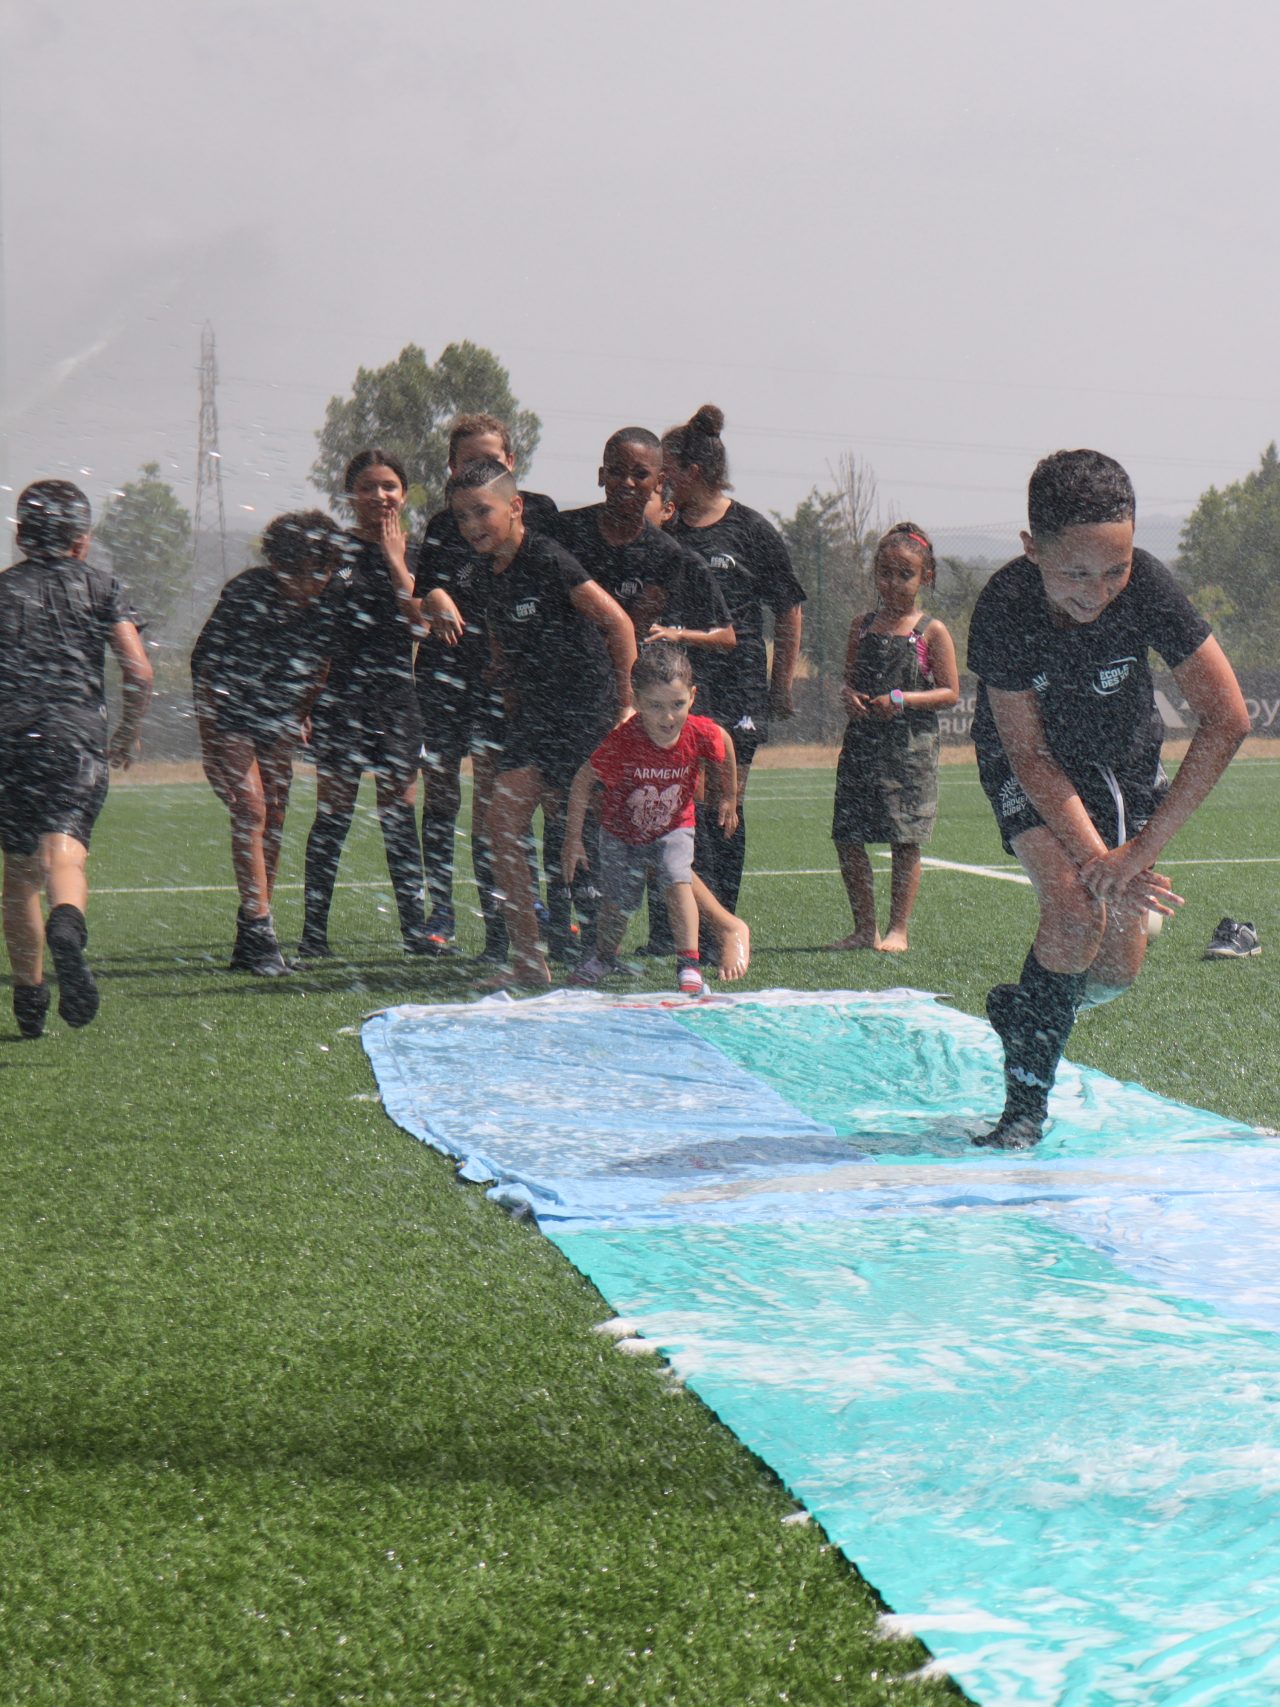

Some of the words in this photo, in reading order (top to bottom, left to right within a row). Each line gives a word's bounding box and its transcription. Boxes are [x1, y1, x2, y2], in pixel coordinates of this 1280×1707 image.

[1101, 677, 1120, 689] DES
[633, 766, 689, 779] ARMENIA
[1002, 795, 1028, 810] PROVE
